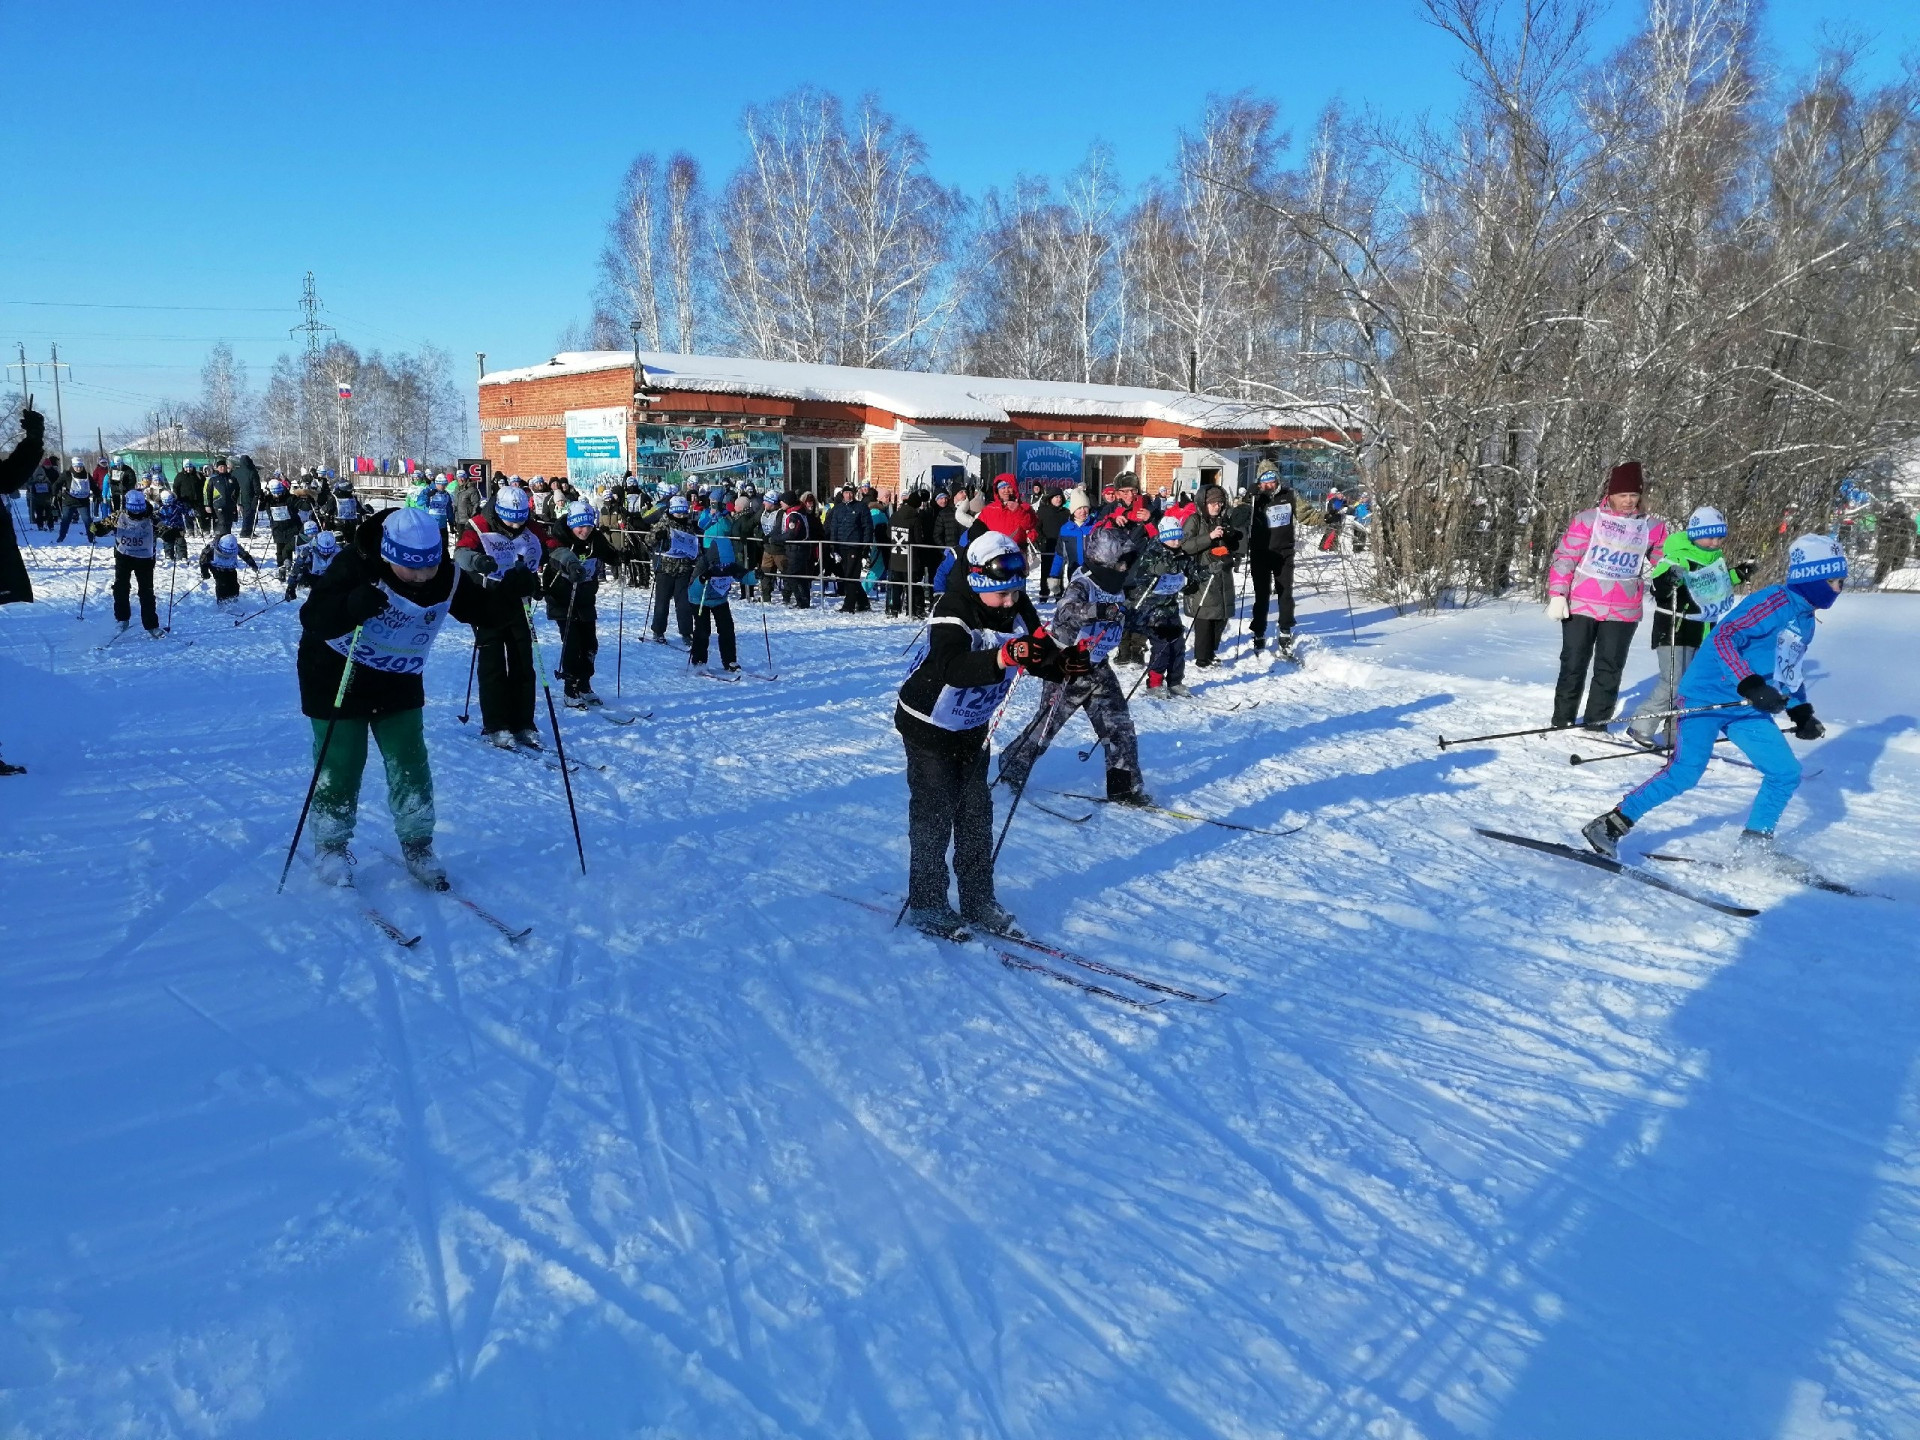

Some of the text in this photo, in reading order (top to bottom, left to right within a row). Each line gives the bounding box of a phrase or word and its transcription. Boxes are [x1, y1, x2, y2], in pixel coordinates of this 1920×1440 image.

[1026, 447, 1073, 460] КОМПЛЕКС
[1029, 462, 1070, 471] ЛЫЖНЫЙ
[121, 536, 144, 547] 6295
[1591, 545, 1640, 568] 12403
